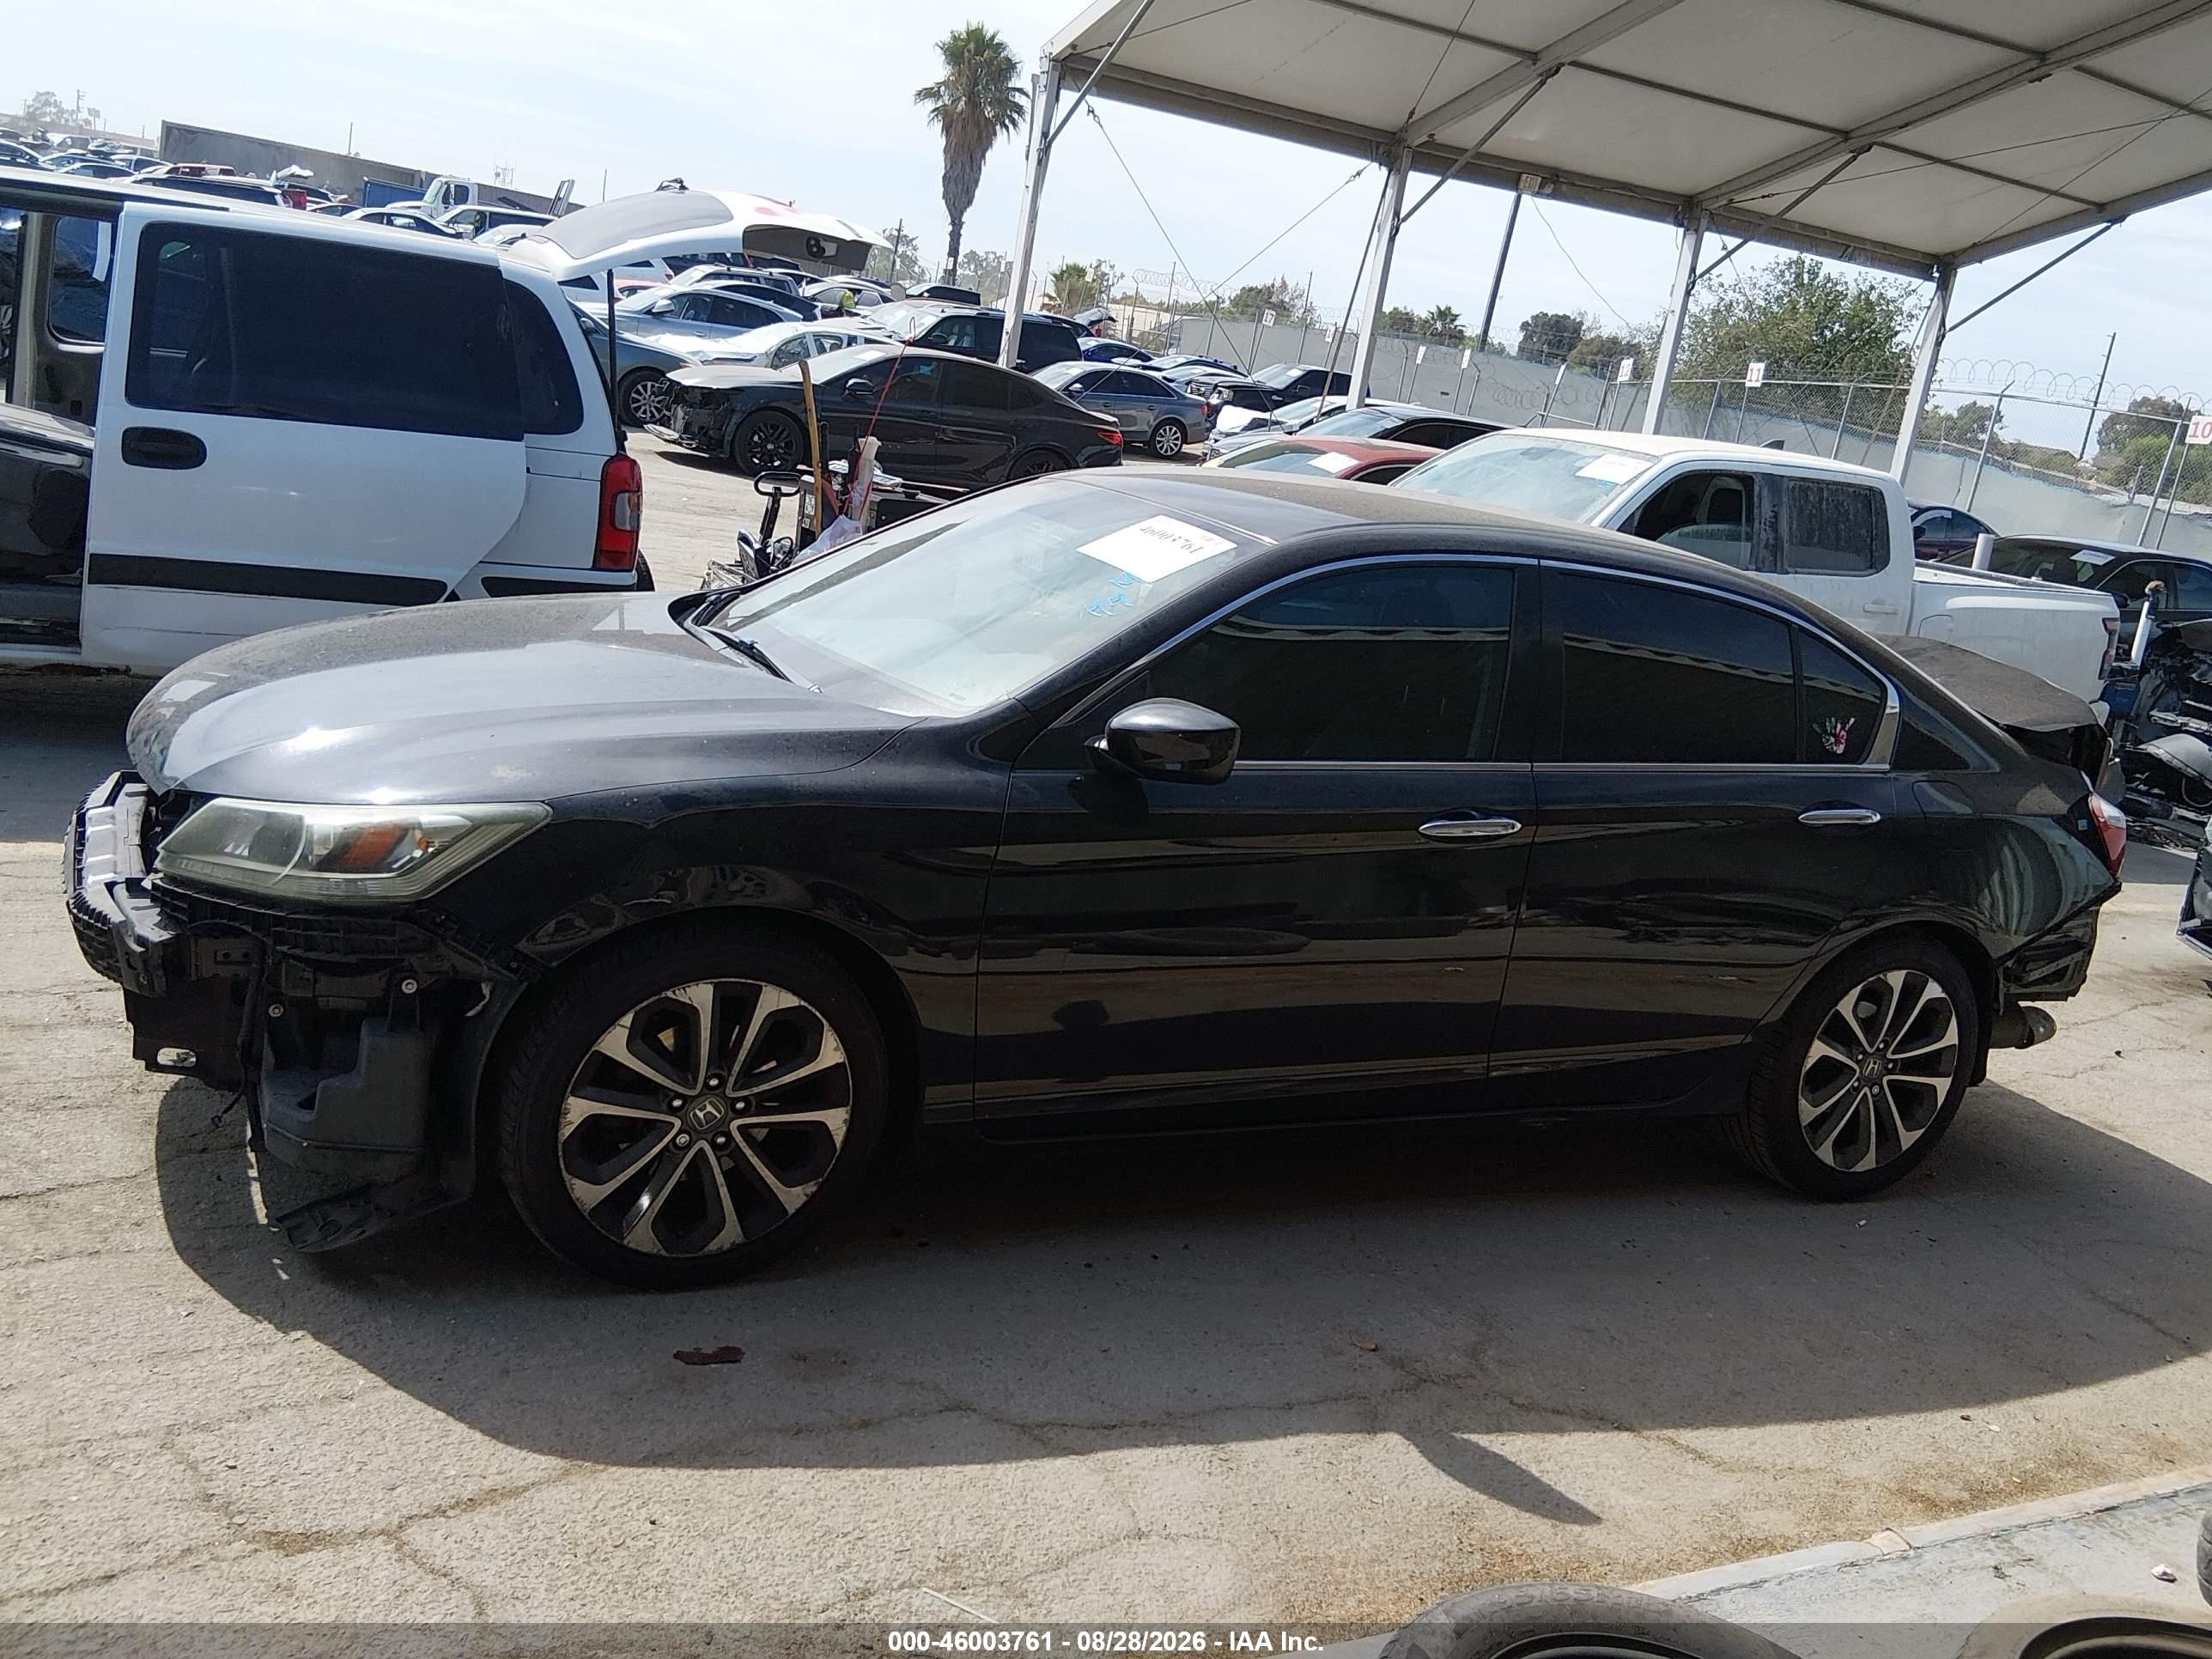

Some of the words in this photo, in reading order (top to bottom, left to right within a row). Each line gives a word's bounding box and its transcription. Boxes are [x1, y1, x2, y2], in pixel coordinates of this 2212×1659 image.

[1264, 312, 1274, 324] 17
[1620, 363, 1632, 378] 12
[1747, 368, 1761, 383] 11
[2188, 421, 2212, 439] 10
